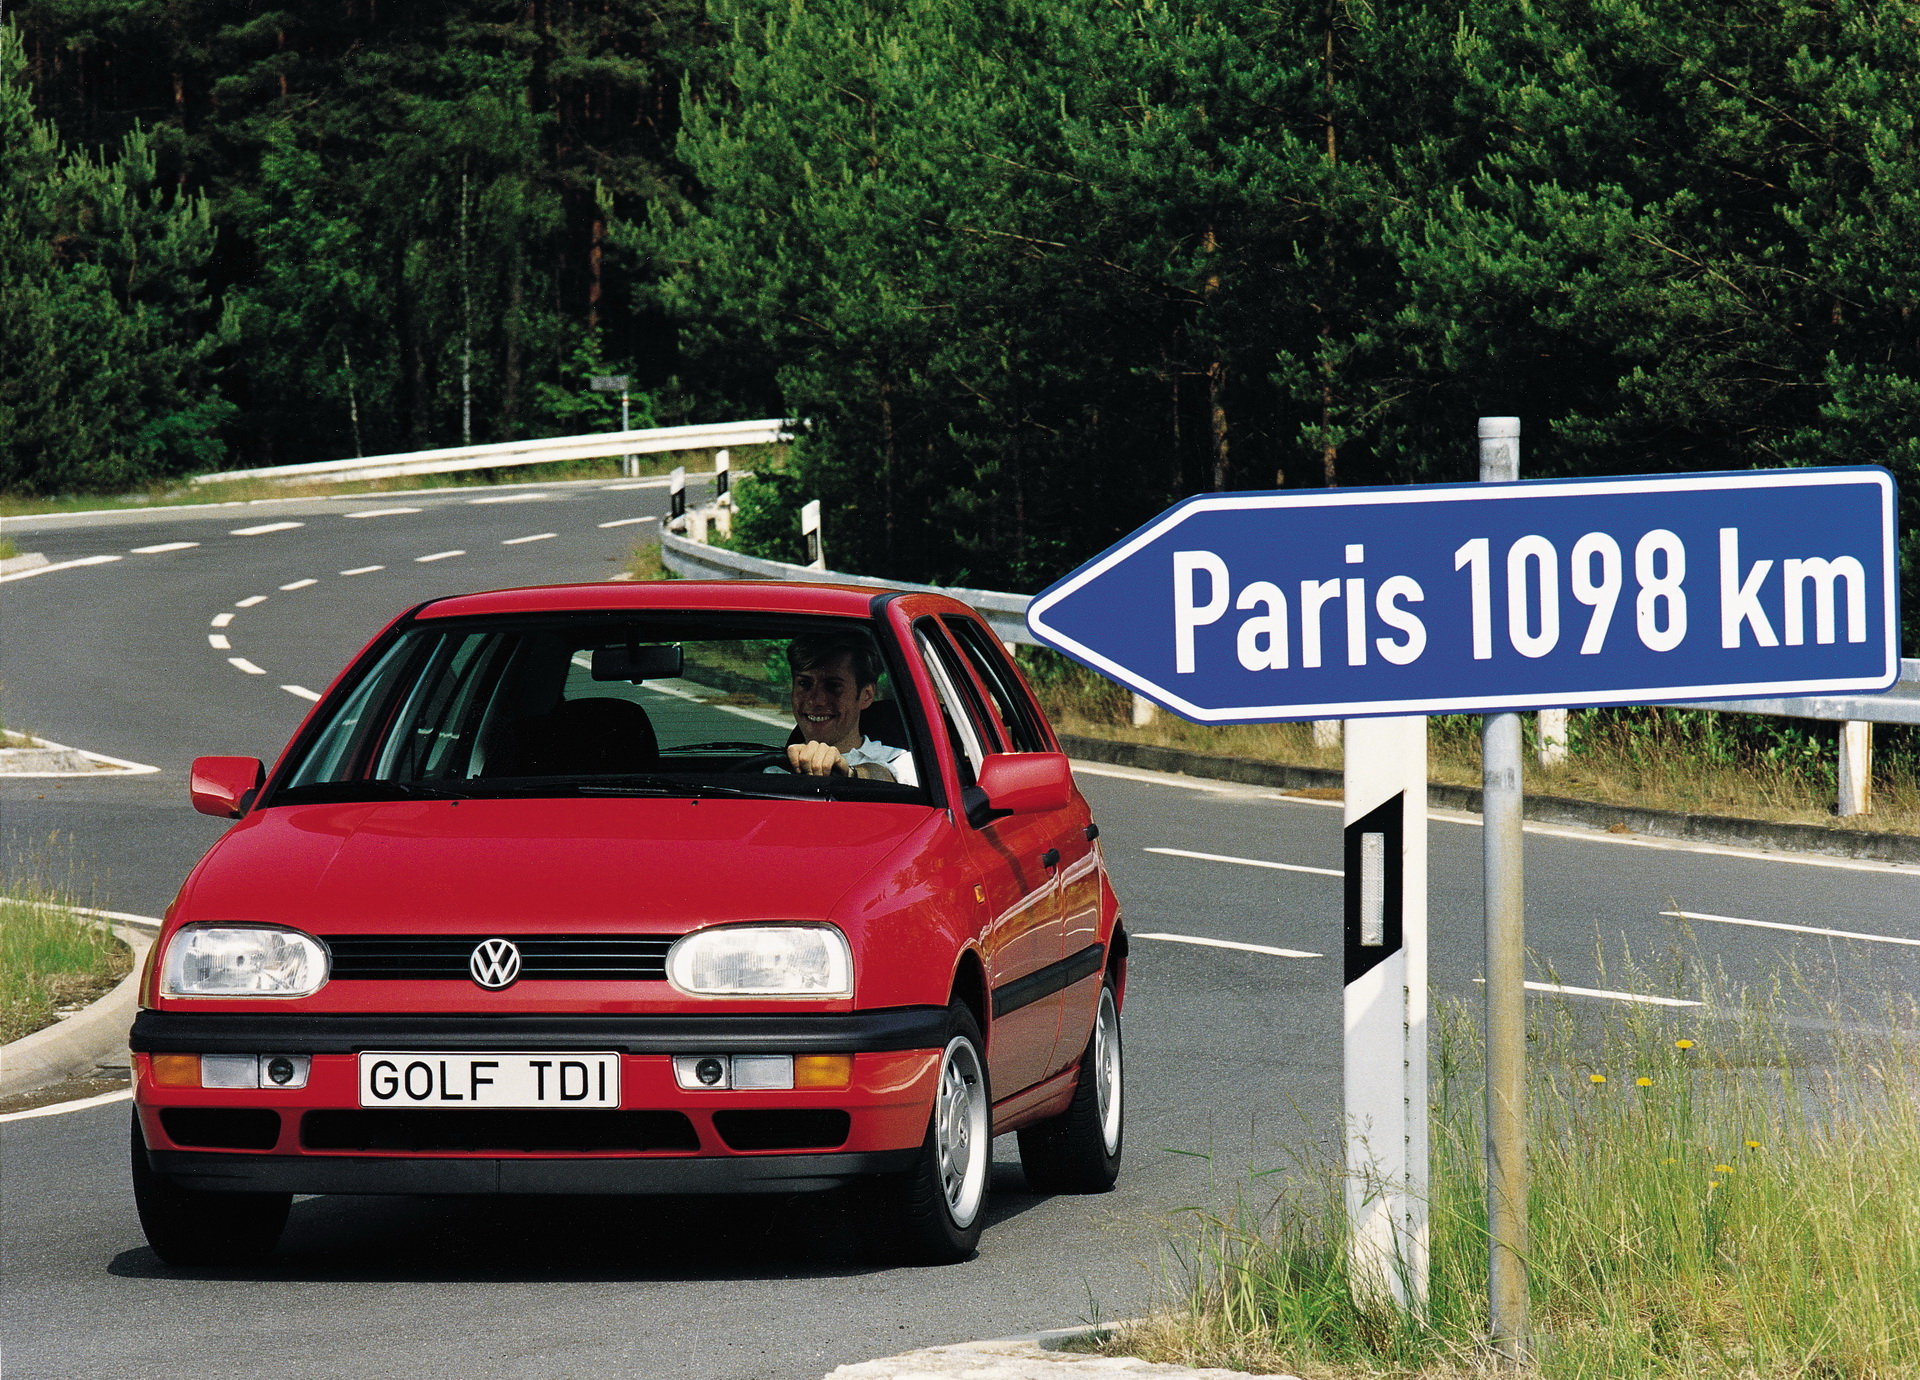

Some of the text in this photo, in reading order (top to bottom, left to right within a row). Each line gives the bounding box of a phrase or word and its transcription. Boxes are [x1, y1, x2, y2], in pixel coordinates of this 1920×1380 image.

[1174, 528, 1867, 674] Paris 1098 km
[470, 938, 520, 988] VW
[370, 1060, 606, 1102] GOLF TDI
